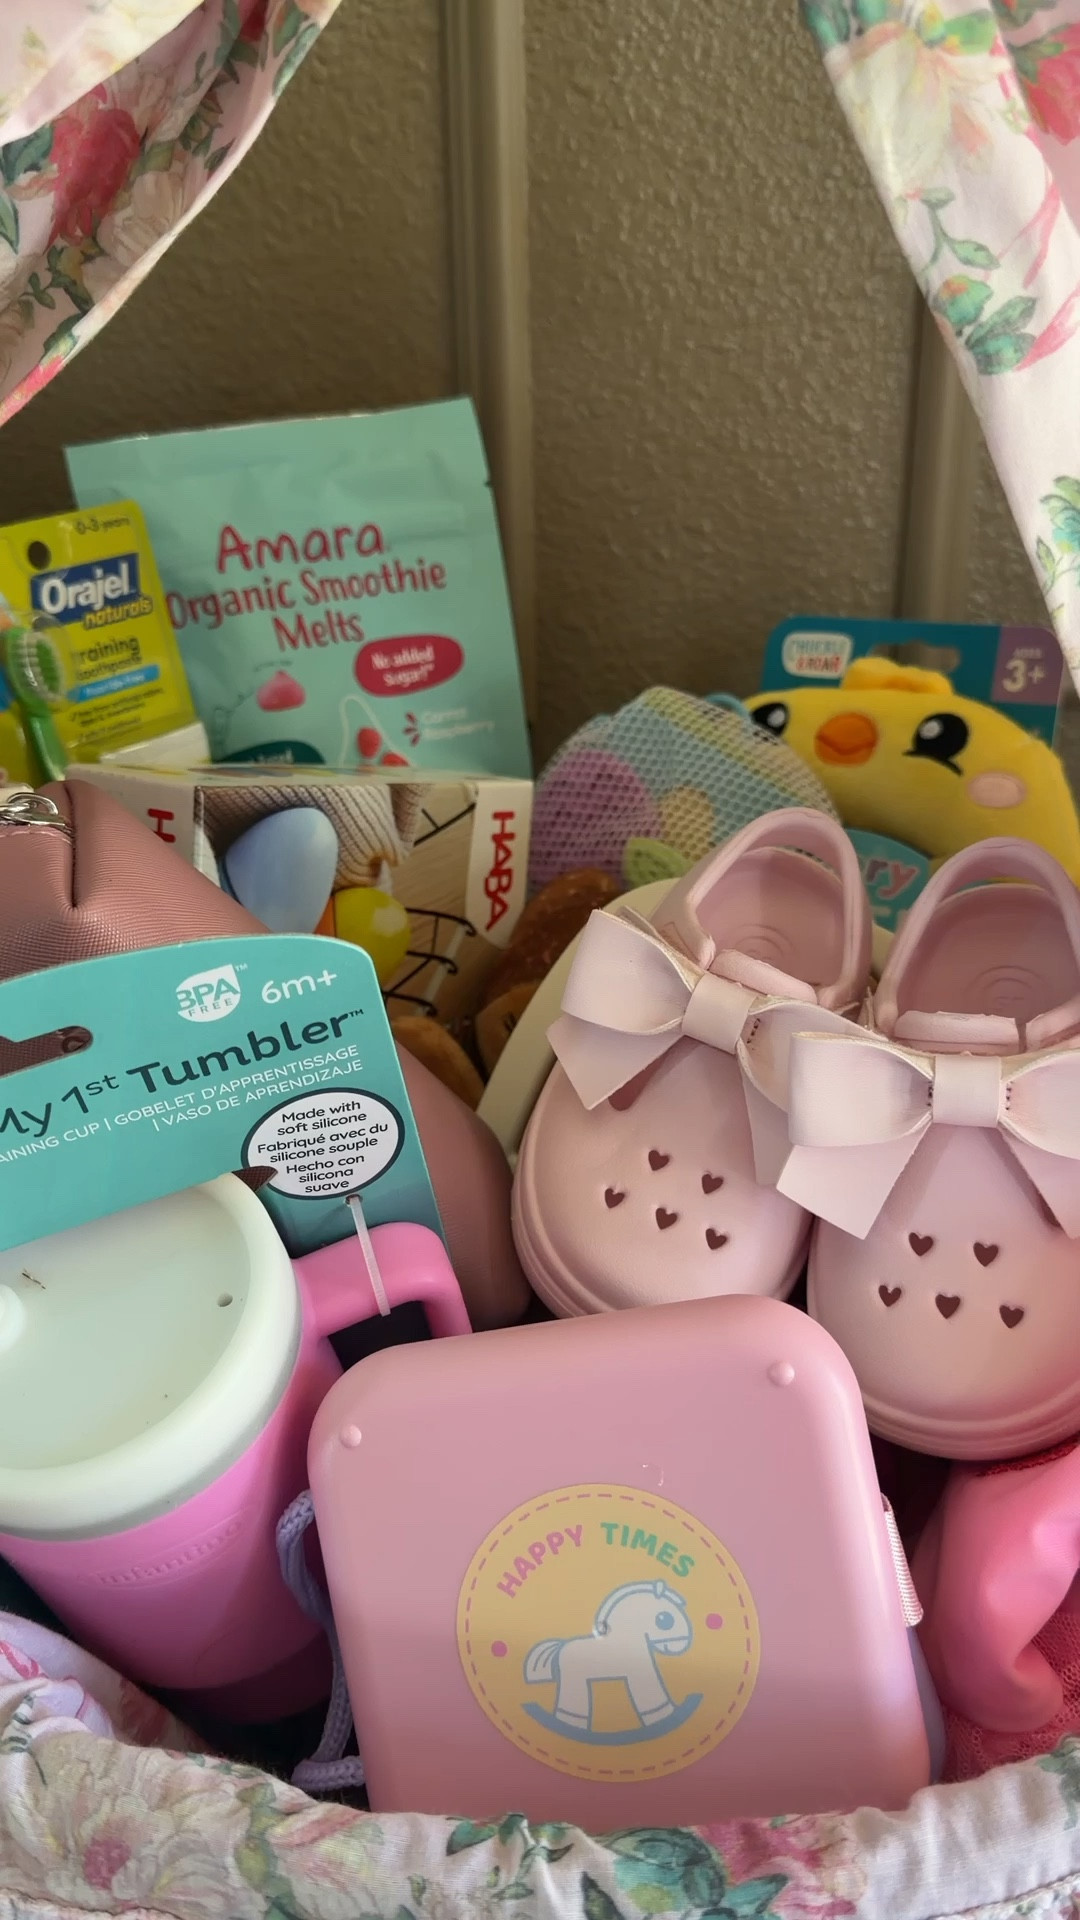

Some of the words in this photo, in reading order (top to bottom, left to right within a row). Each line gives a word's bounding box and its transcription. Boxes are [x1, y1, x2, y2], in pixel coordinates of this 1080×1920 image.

[216, 522, 384, 574] Amara
[41, 561, 131, 614] Orajel
[165, 576, 296, 630] Organic
[299, 557, 447, 606] Smoothie
[84, 598, 153, 630] naturals
[272, 609, 365, 651] Melts
[1002, 659, 1046, 693] 3+
[484, 811, 516, 933] HABA
[175, 977, 240, 1011] BPA
[261, 969, 337, 1004] 6m+
[188, 997, 234, 1017] FREE
[0, 1136, 60, 1163] AINING
[63, 1122, 100, 1142] CUP
[114, 1092, 196, 1126] GOBELET
[202, 1045, 359, 1100] D'APPRENTISSAGE
[61, 1075, 120, 1114] 1st
[162, 1104, 212, 1127] VASO
[216, 1095, 241, 1112] DE
[245, 1059, 363, 1103] APRENDIZAJE
[277, 1122, 308, 1136] soft
[312, 1113, 367, 1130] silicone
[282, 1108, 325, 1123] Made
[329, 1101, 361, 1115] with
[257, 1134, 326, 1154] Fabriqué
[329, 1128, 366, 1142] avec
[369, 1123, 388, 1134] du
[270, 1147, 325, 1163] silicone
[329, 1137, 378, 1153] souple
[286, 1160, 333, 1174] Hecho
[338, 1155, 365, 1167] con
[299, 1168, 354, 1183] silicona
[305, 1180, 350, 1193] suave
[496, 1524, 583, 1598] HAPPY
[600, 1522, 695, 1578] TIMES
